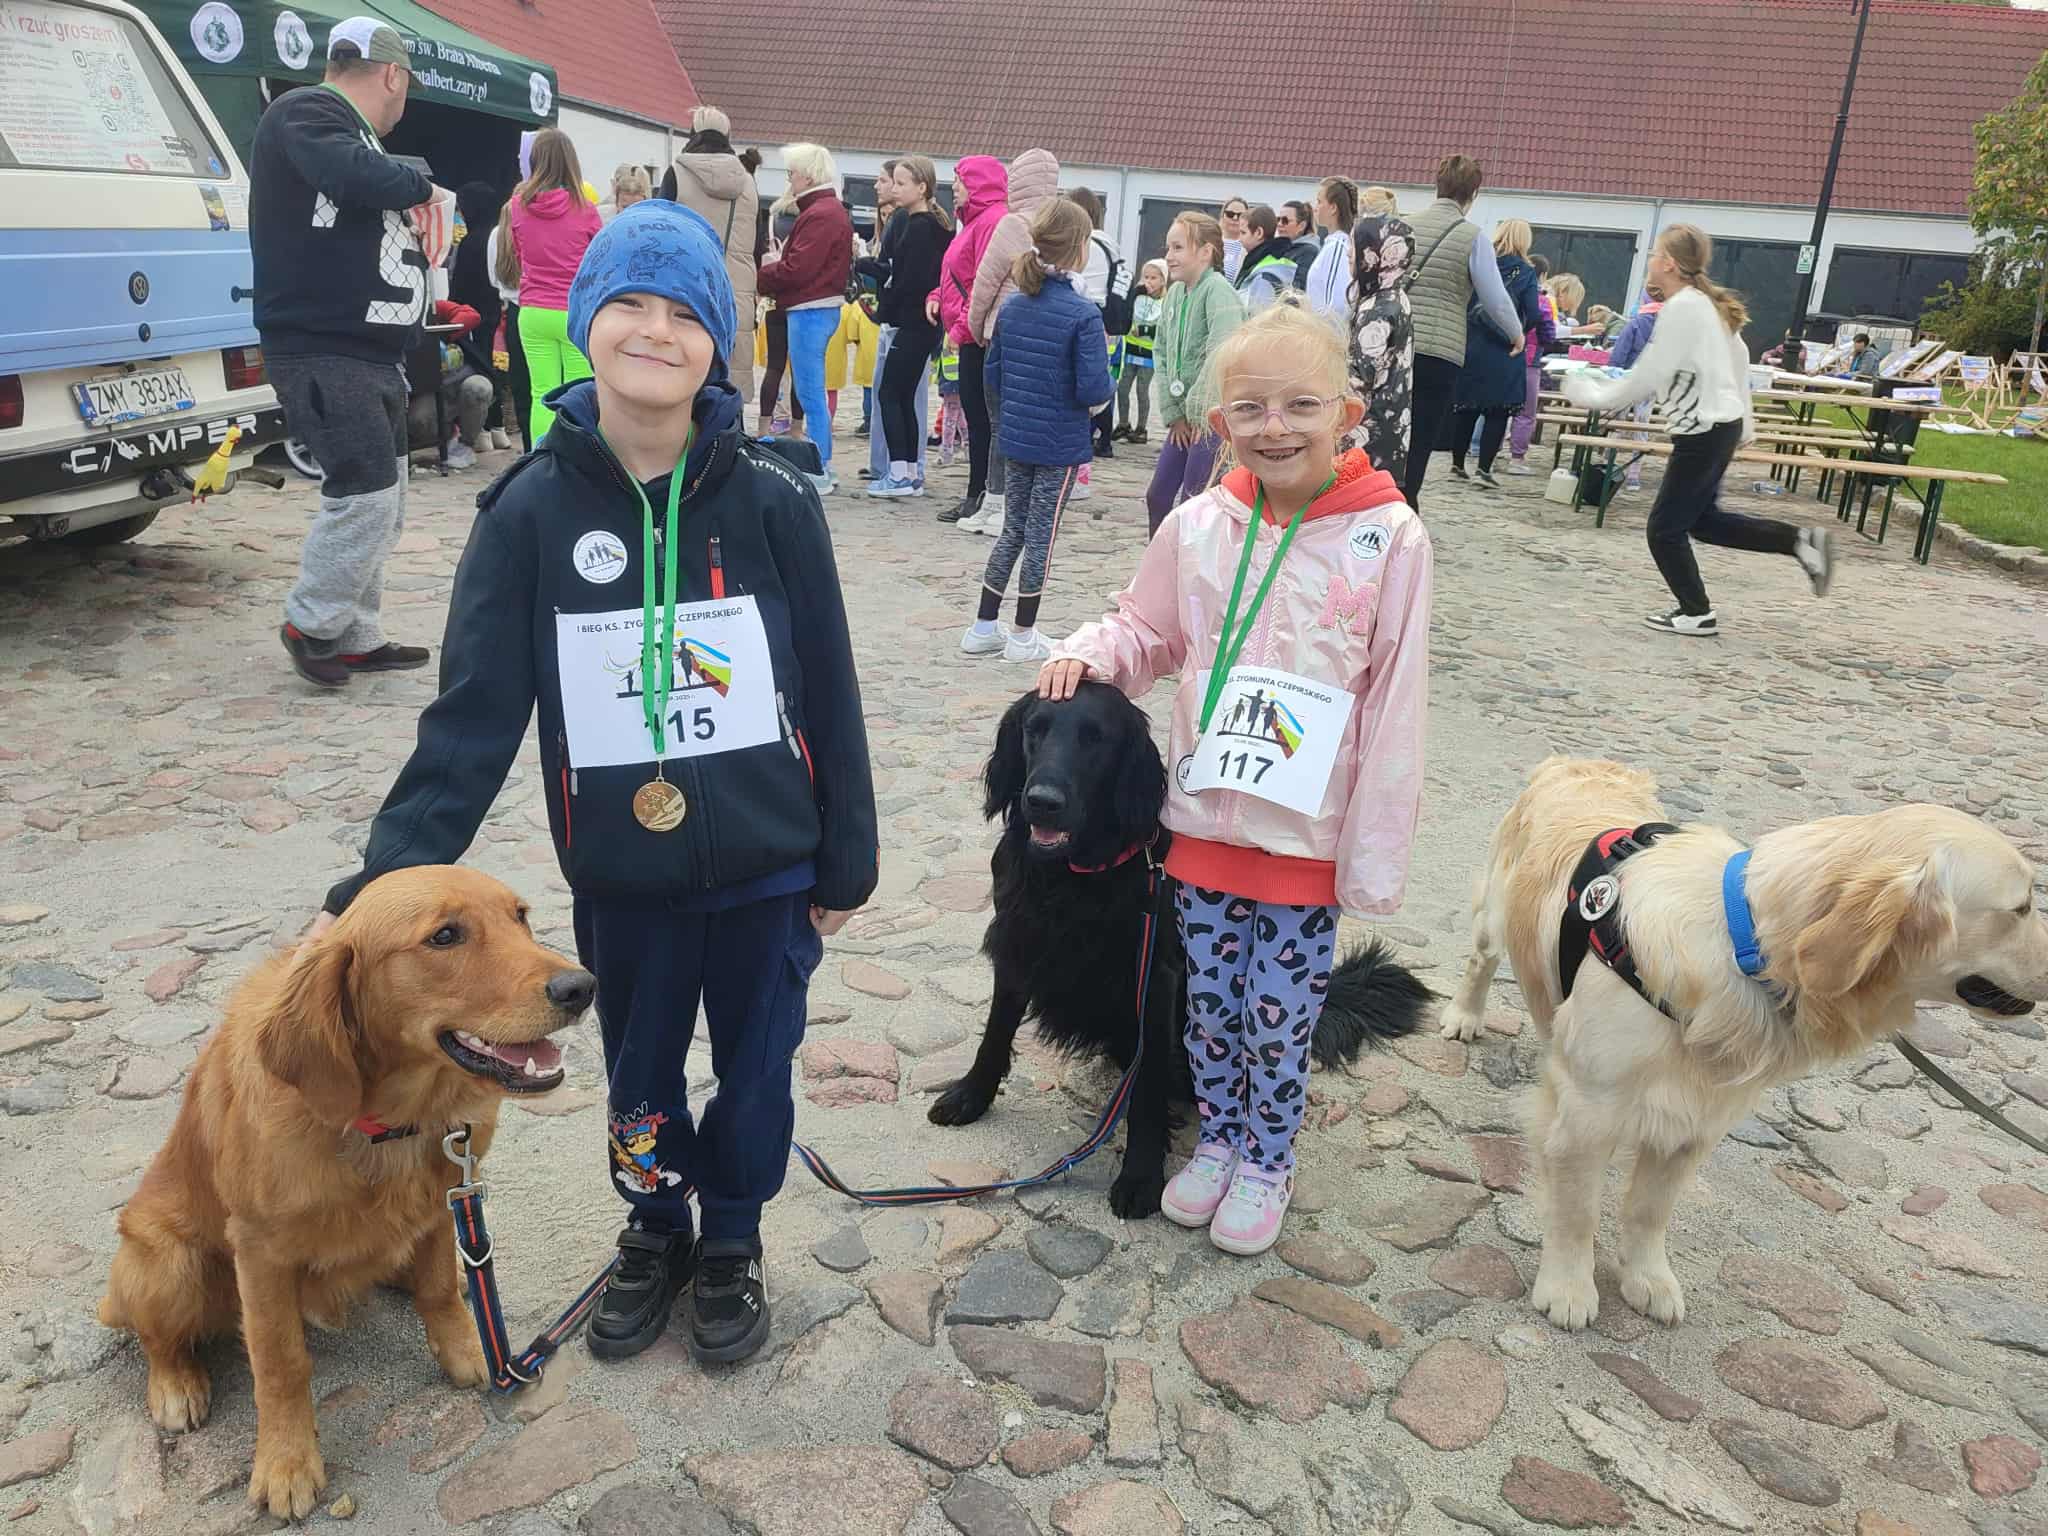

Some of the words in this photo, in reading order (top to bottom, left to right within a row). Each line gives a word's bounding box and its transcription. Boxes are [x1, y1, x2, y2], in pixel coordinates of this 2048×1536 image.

[437, 41, 465, 65] Brata
[88, 382, 129, 415] ZMY
[130, 373, 189, 407] 383AX
[581, 624, 602, 633] BIEG
[604, 621, 621, 633] KS.
[678, 607, 743, 622] CZEPIRSKIEGO
[1219, 750, 1275, 784] 117
